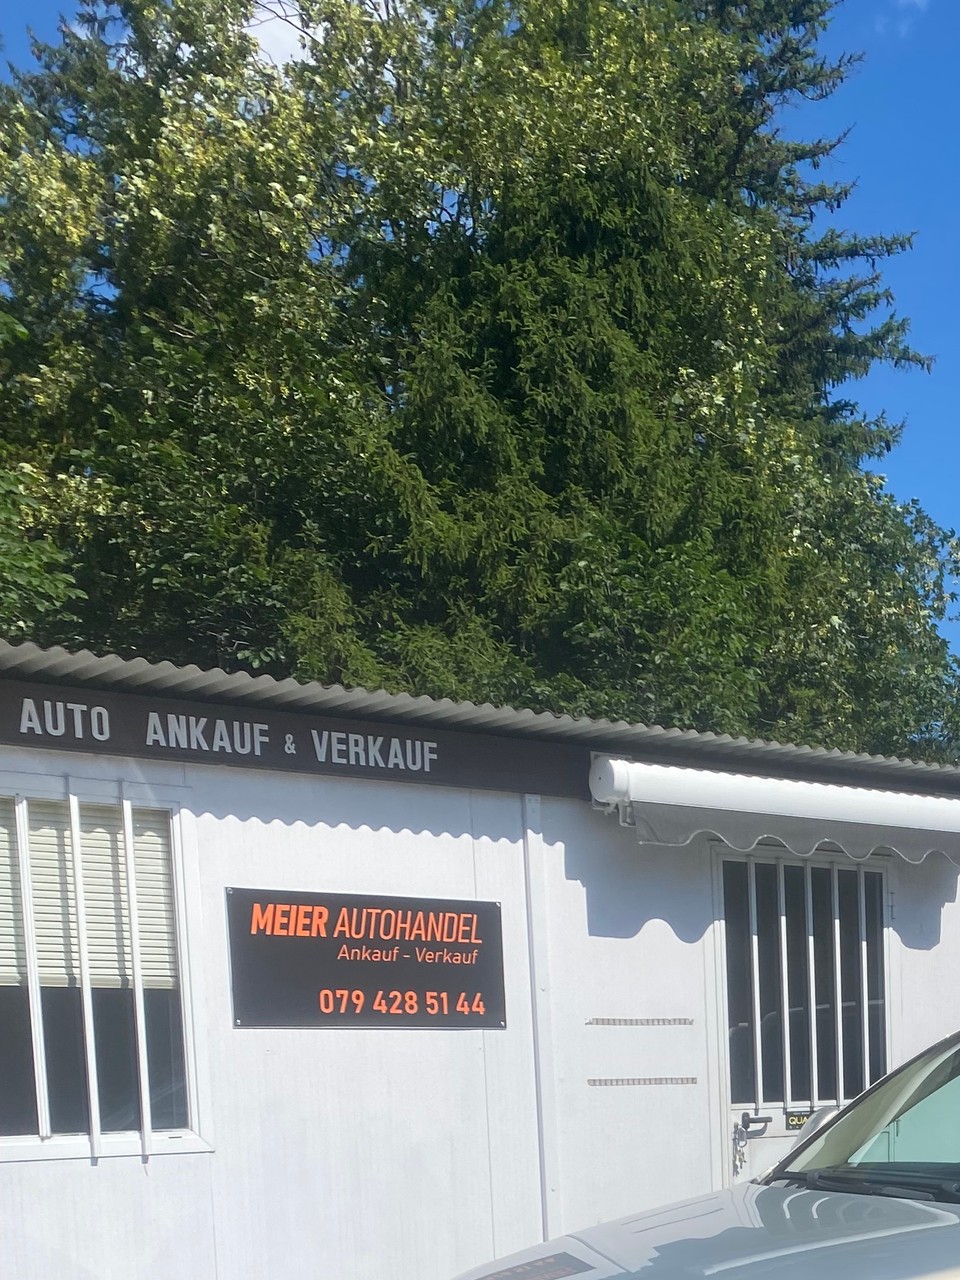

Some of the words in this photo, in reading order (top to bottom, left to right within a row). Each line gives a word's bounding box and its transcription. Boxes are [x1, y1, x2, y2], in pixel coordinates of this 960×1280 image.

[19, 698, 110, 741] AUTO
[146, 711, 270, 756] ANKAUF
[284, 733, 297, 755] &
[311, 729, 438, 772] VERKAUF
[250, 903, 329, 938] MEIER
[333, 907, 483, 944] AUTOHANDEL
[337, 944, 400, 962] Ankauf
[415, 947, 479, 965] Verkauf
[319, 989, 365, 1014] 079
[373, 990, 419, 1015] 428
[426, 991, 449, 1015] 51
[456, 992, 486, 1015] 44
